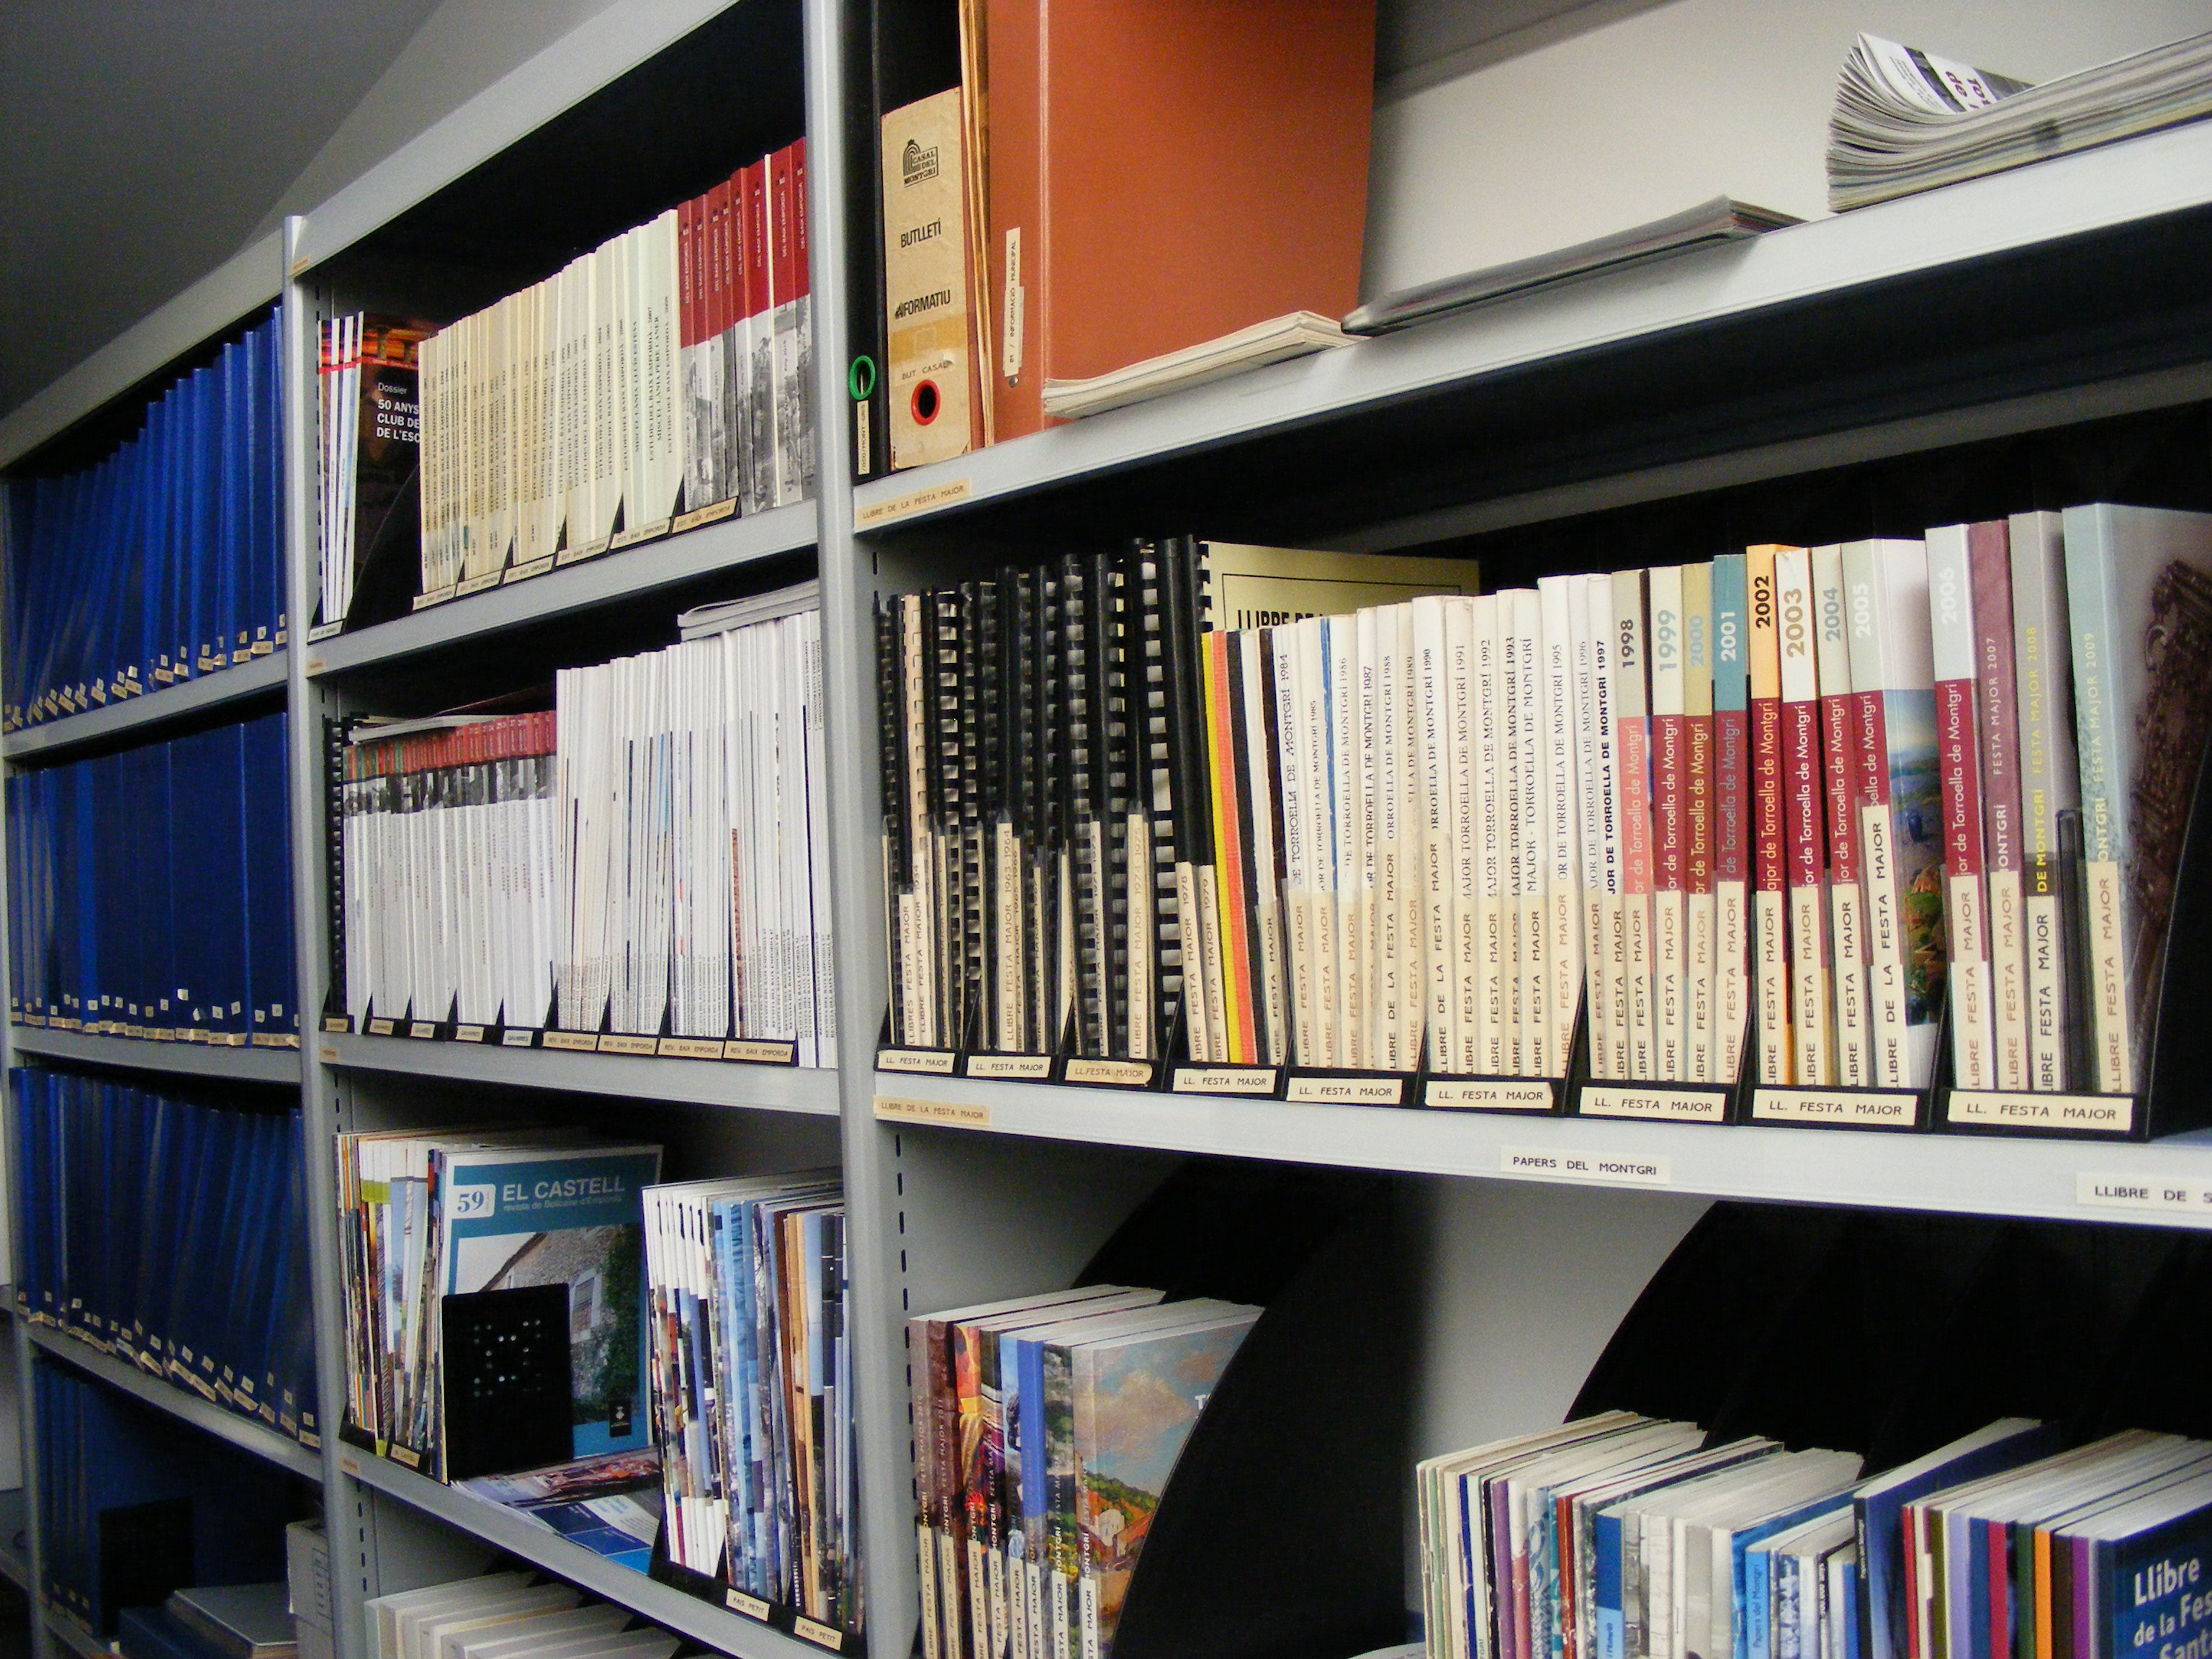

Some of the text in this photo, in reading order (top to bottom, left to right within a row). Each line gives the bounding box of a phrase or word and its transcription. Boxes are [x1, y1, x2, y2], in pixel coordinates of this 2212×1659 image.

[912, 150, 936, 165] CASAL
[922, 159, 936, 170] DEL
[901, 217, 942, 248] BUTLLETÍ
[377, 398, 419, 415] 50 ANYS
[378, 383, 408, 394] Dossier
[377, 413, 405, 426] CLUB
[377, 427, 391, 438] DE
[887, 504, 896, 513] DE
[901, 500, 909, 508] LA
[914, 493, 937, 505] FESTA
[940, 485, 964, 499] MAJOR
[1755, 575, 1771, 629] 2002
[1824, 588, 1840, 642] 2004
[1853, 583, 1871, 639] 2005
[1939, 567, 1956, 624] 2006
[1620, 619, 1635, 668] 1998
[1658, 610, 1677, 672] 1999
[1689, 615, 1704, 667] 2000
[1721, 611, 1736, 662] 2001
[1784, 588, 1804, 658] 2003
[1552, 644, 1562, 669] 1995
[1524, 712, 1534, 733] DE
[1858, 694, 1876, 772] de Montgrí
[1555, 738, 1565, 756] DE
[1601, 742, 1610, 759] DE
[1946, 683, 1966, 853] de Torroella de Montgrí
[2026, 626, 2048, 893] DE MONTGRÍ FESTA MAJOR 2008
[1525, 737, 1536, 827] TORROELLA
[1555, 760, 1566, 837] TORROELLA
[1661, 718, 1678, 872] de Torroella de Montgrí
[1757, 702, 1778, 860] de Torroella de Montgrí
[1795, 704, 1813, 865] de Torroella de Montgrí
[1827, 698, 1848, 859] de Torroella de Montgrí
[1602, 764, 1614, 841] TORROELLA
[1626, 725, 1643, 879] de Torroella de Montgrí
[1689, 723, 1707, 879] de Torroella de Montgrí
[1526, 839, 1537, 891] MAJOR
[1557, 841, 1567, 860] DE
[1606, 848, 1614, 864] DE
[1875, 822, 1895, 1022] DE LA FESTA MAJOR
[1462, 913, 1473, 1023] FESTA MAJOR
[1531, 910, 1541, 1023] FESTA MAJOR
[1665, 907, 1674, 1026] FESTA MAJOR
[1727, 898, 1737, 1020] FESTA MAJOR
[1842, 902, 1855, 1027] FESTA MAJOR
[2099, 878, 2117, 1016] FESTA MAJOR
[1387, 971, 1395, 989] LA
[2036, 913, 2051, 1036] FESTA MAJOR
[1388, 1000, 1395, 1020] DE
[899, 1057, 921, 1066] FESTA
[925, 1058, 948, 1067] MAJOR
[991, 1063, 1014, 1071] FESTA
[1019, 1064, 1044, 1072] MAJOR
[1202, 1076, 1231, 1086] FESTA
[1237, 1076, 1267, 1086] MAJOR
[881, 1102, 984, 1119] LLIBRE DE LA FESTA MAJOR
[1321, 1087, 1352, 1096] FESTA
[1359, 1087, 1393, 1097] MAJOR
[1461, 1090, 1498, 1100] FESTA
[1506, 1091, 1543, 1101] MAJOR
[1621, 1098, 1660, 1110] FESTA
[1671, 1101, 1712, 1112] MAJOR
[1799, 1101, 1844, 1113] FESTA
[1855, 1103, 1903, 1116] MAJOR
[2000, 1104, 2051, 1118] FESTA
[2062, 1106, 2117, 1120] MAJOR
[1513, 1156, 1656, 1176] PAPERS DEL MONTGRI
[457, 1190, 485, 1213] 59
[503, 1176, 626, 1202] EL CASTELL
[2094, 1184, 2149, 1200] LLIBRE
[2162, 1190, 2187, 1202] DE
[2134, 1557, 2200, 1607] Llibre
[819, 1632, 835, 1642] PETIT
[2134, 1620, 2155, 1648] de
[2159, 1611, 2175, 1637] la
